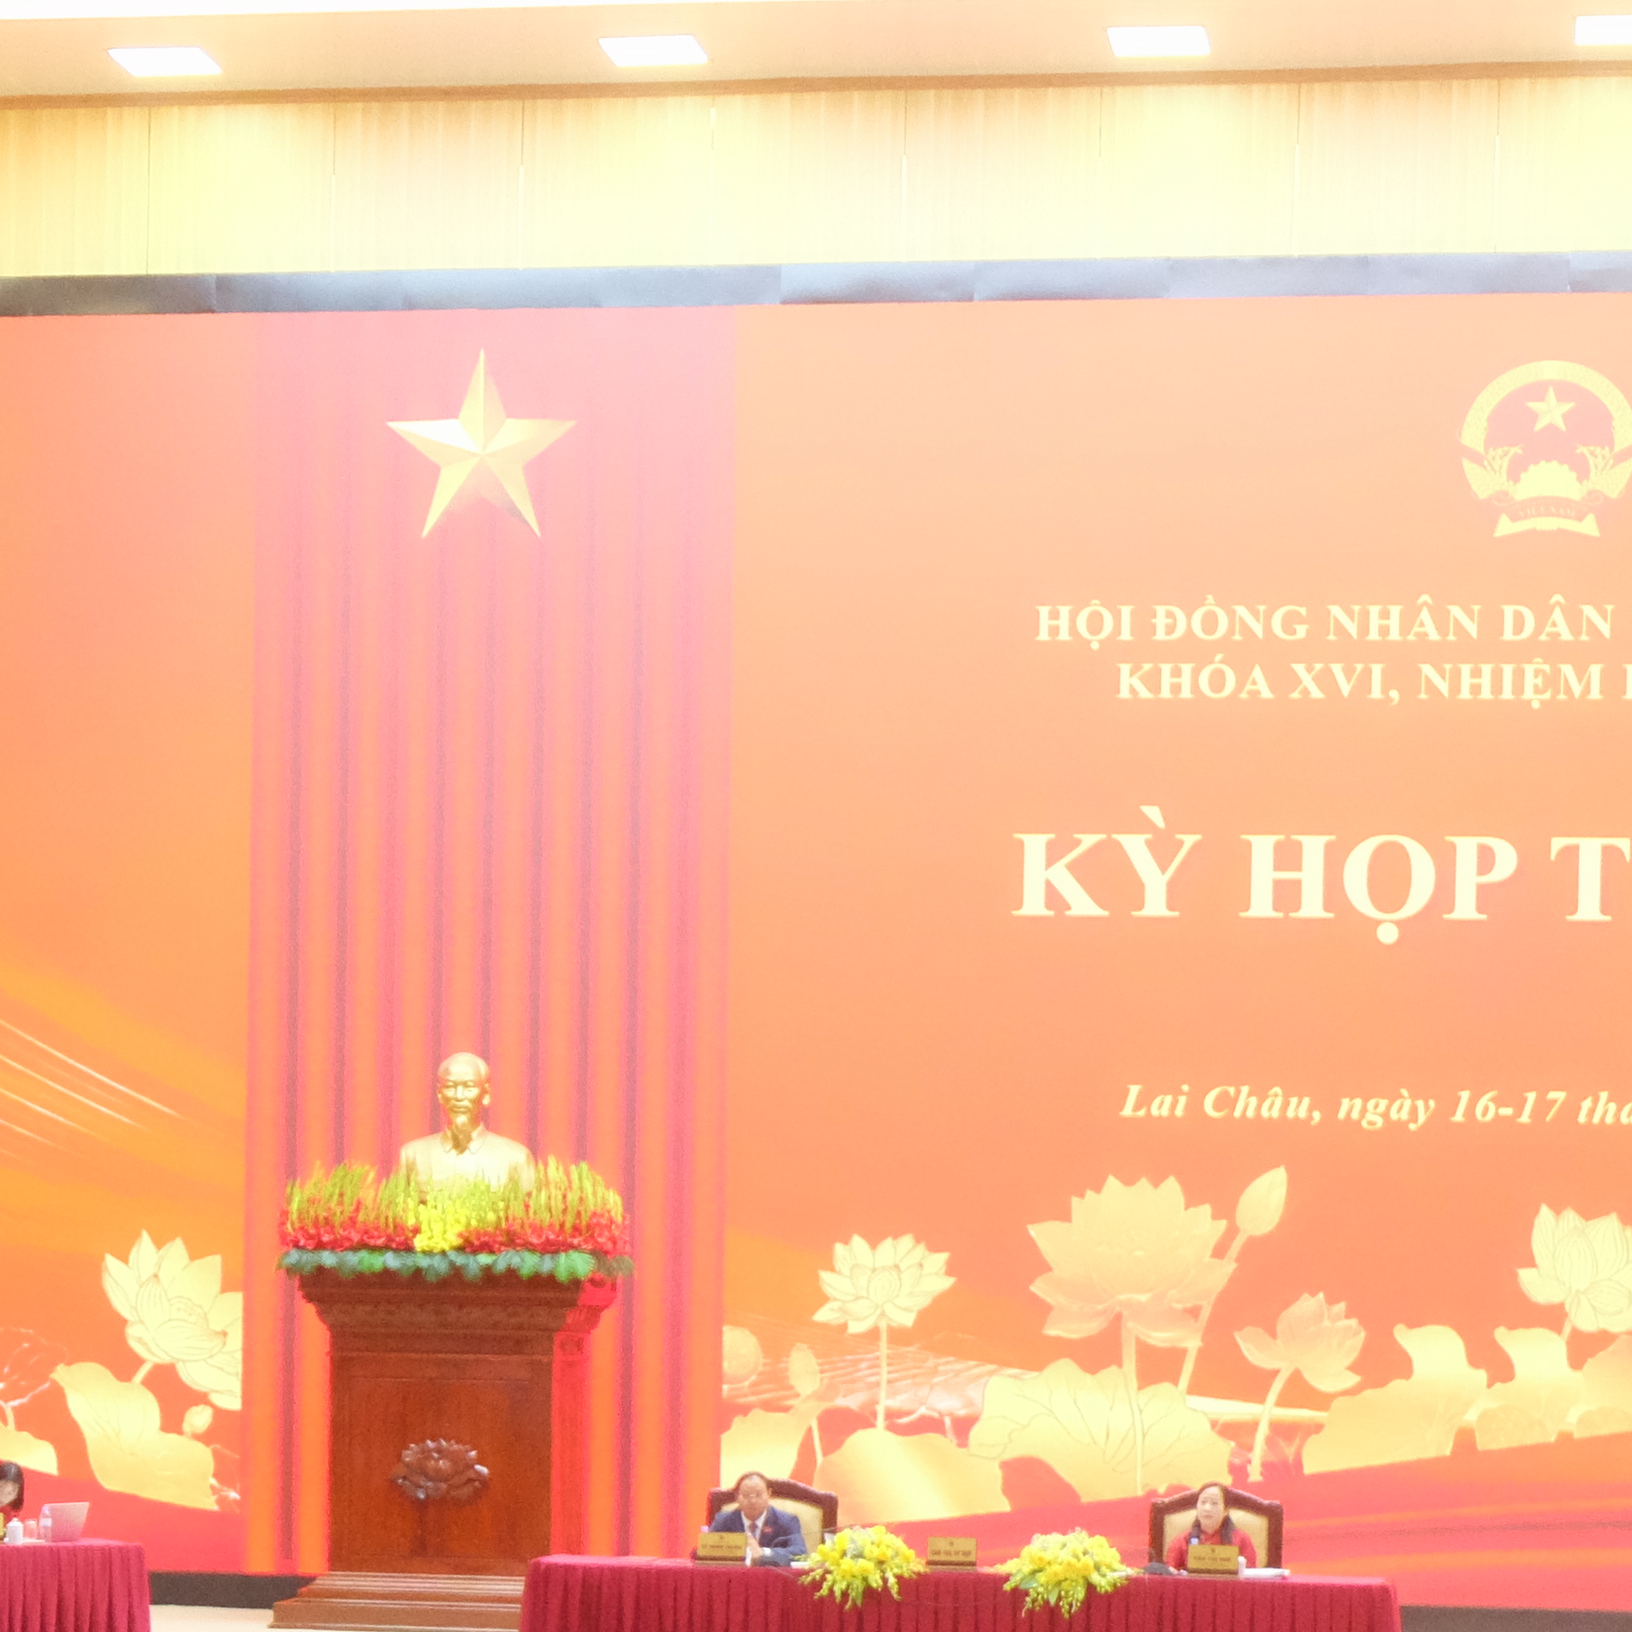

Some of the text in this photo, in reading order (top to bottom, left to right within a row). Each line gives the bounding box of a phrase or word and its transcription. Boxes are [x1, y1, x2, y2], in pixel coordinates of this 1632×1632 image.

[1035, 600, 1134, 650] HỘI
[1151, 595, 1309, 641] ĐỒNG
[1327, 594, 1481, 641] NHÂN
[1501, 594, 1614, 641] DÂN
[1117, 654, 1274, 700] KHÓA
[1289, 662, 1399, 706] XVI,
[1418, 657, 1603, 709] NHIỆM
[1011, 805, 1202, 917] KỲ
[1239, 835, 1518, 945] HỌP
[1119, 1083, 1190, 1119] Lai
[1204, 1084, 1321, 1126] Châu,
[1337, 1086, 1436, 1132] ngày
[1450, 1090, 1567, 1125] 16-17
